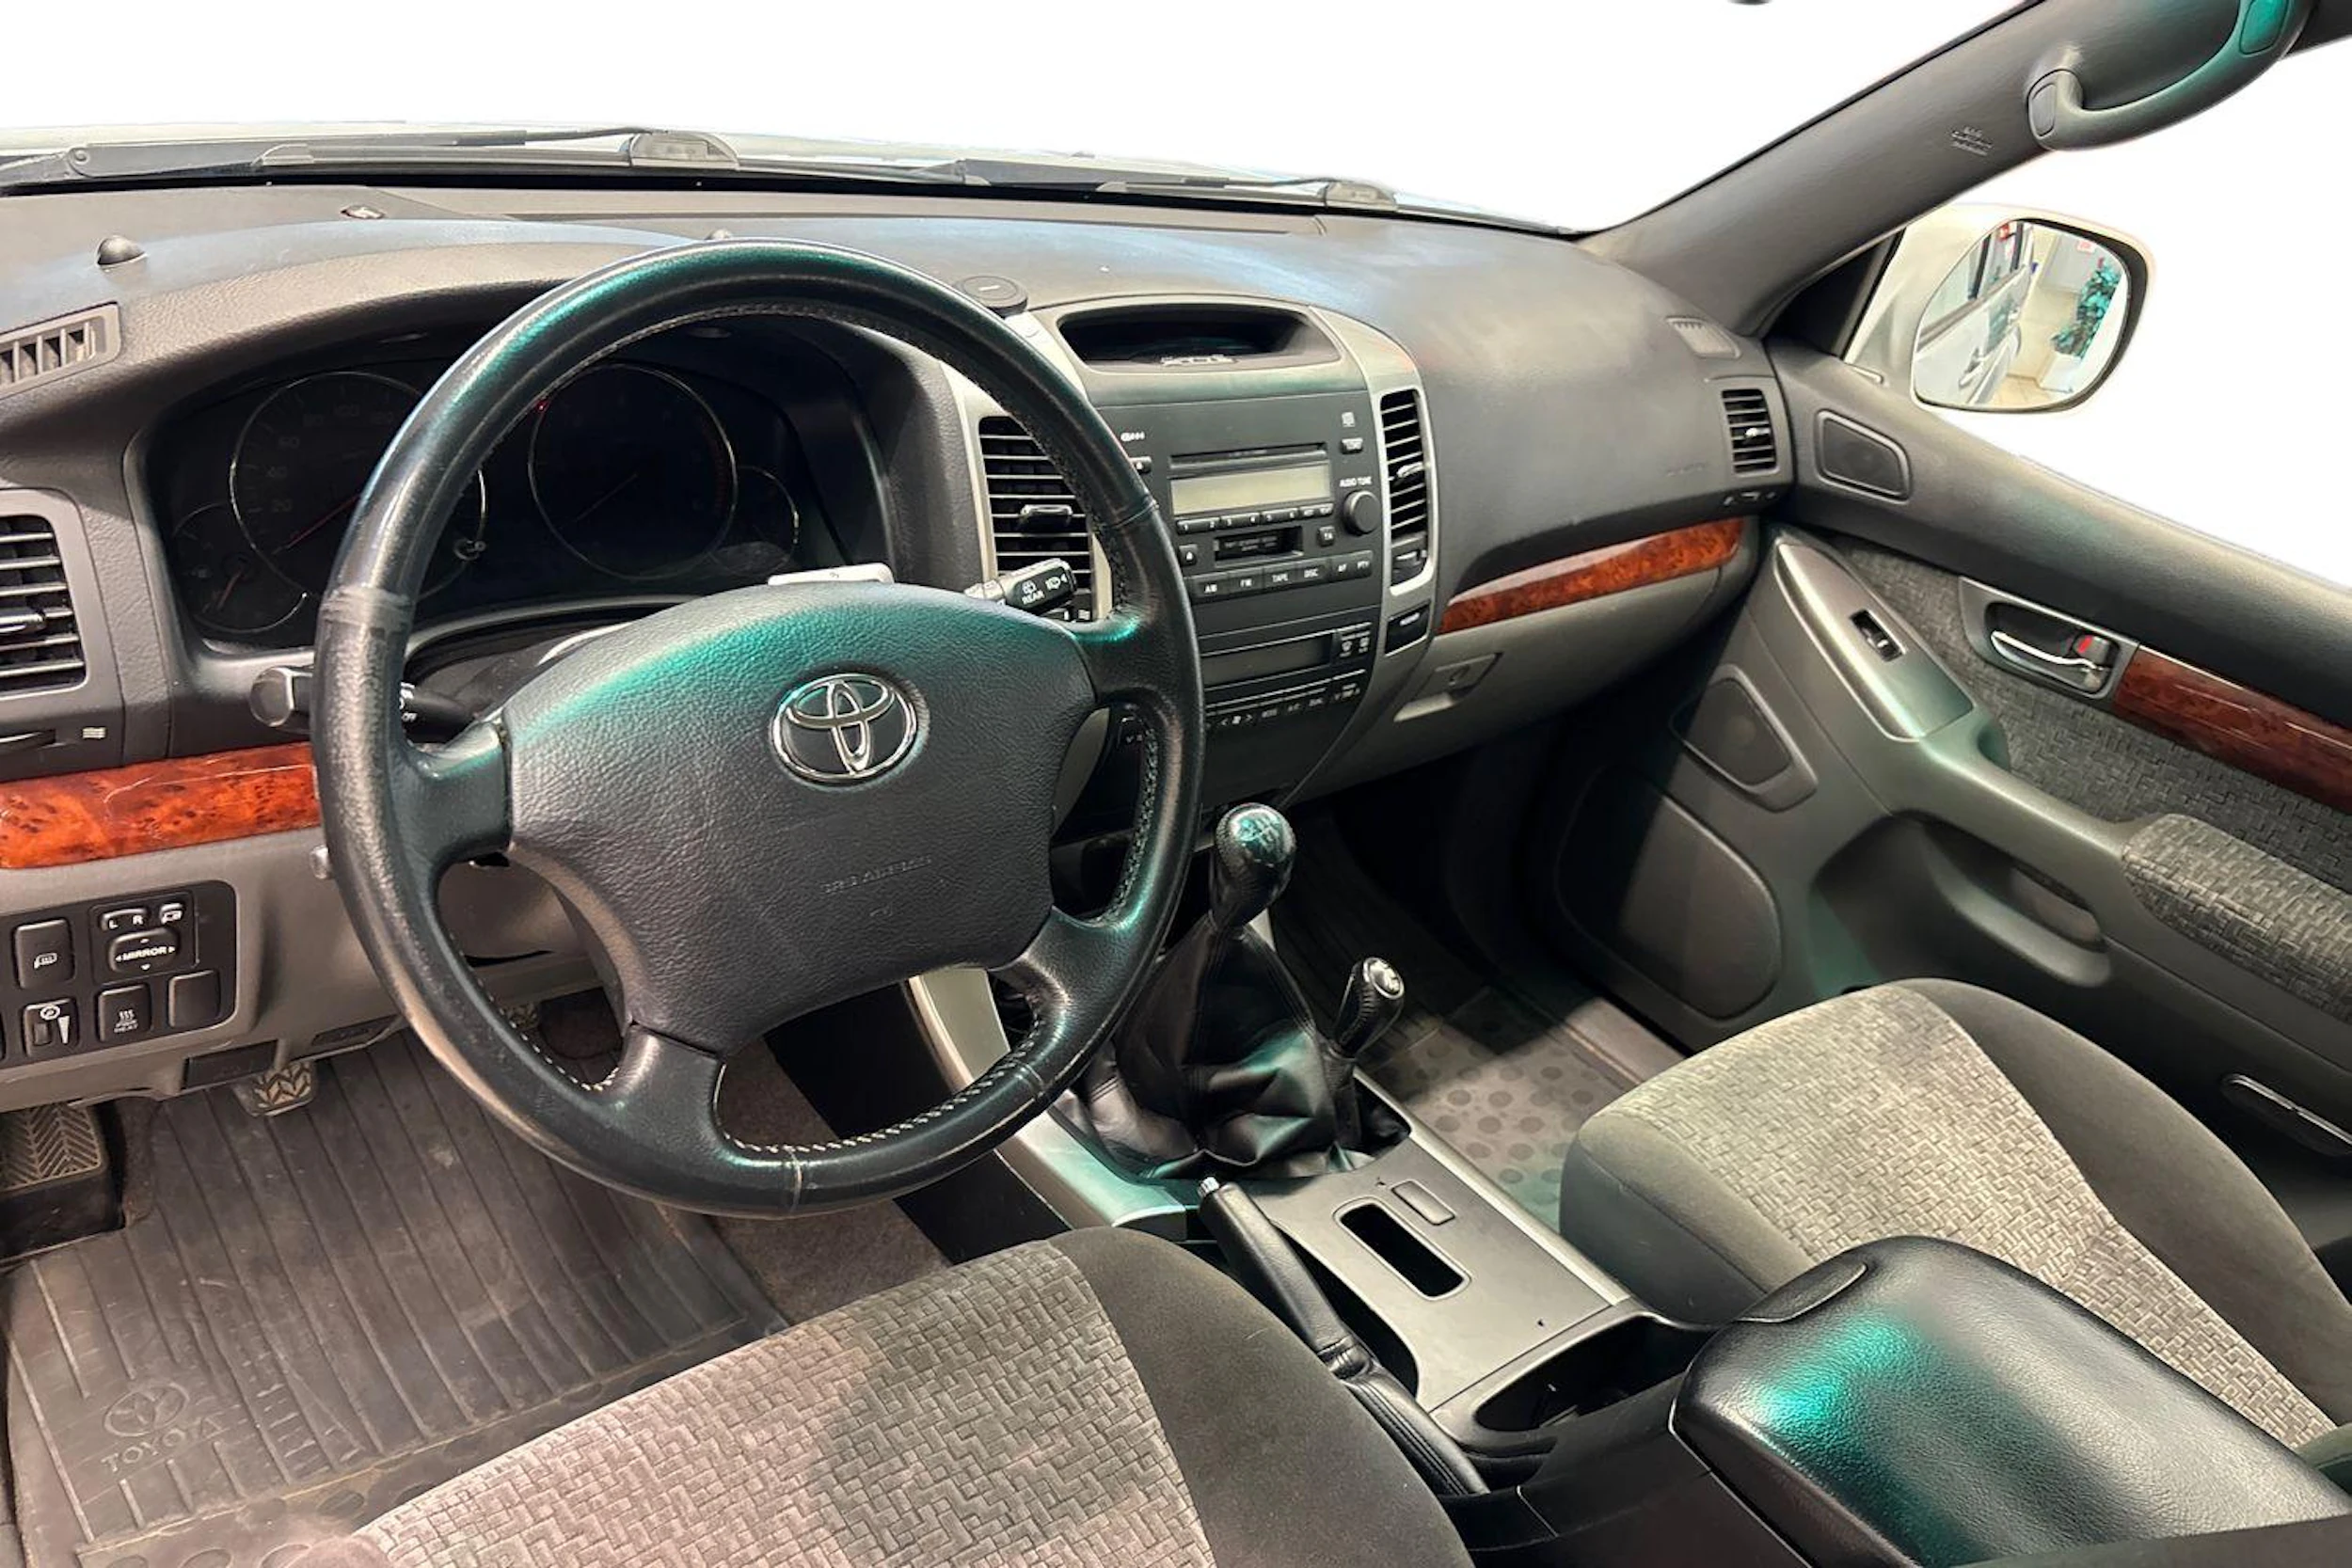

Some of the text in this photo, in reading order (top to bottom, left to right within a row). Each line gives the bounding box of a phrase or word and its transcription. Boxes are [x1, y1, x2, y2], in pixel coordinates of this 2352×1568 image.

[109, 921, 119, 929] L
[132, 915, 144, 926] R
[122, 945, 167, 961] MIRROR
[101, 1416, 230, 1473] TOYOTA
